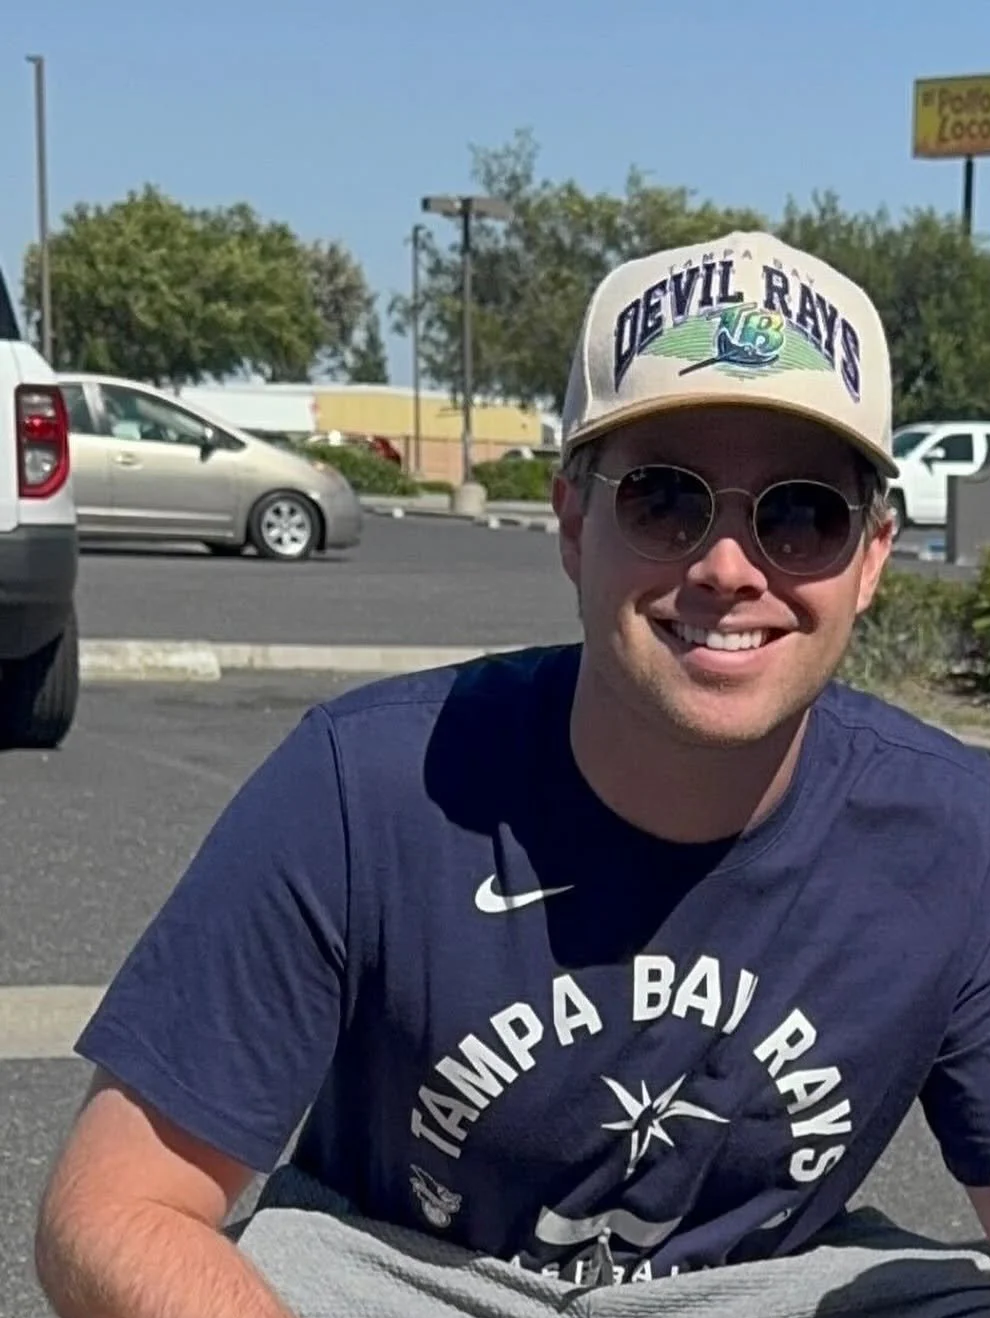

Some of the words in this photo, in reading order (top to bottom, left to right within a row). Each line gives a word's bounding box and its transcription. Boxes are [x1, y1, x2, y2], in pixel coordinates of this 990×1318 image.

[613, 260, 744, 393] DEVIL
[762, 264, 860, 403] RAYS
[668, 249, 752, 275] TAMPA
[773, 257, 815, 284] BAY
[410, 973, 603, 1159] TAMPA
[752, 1008, 852, 1182] RAYS
